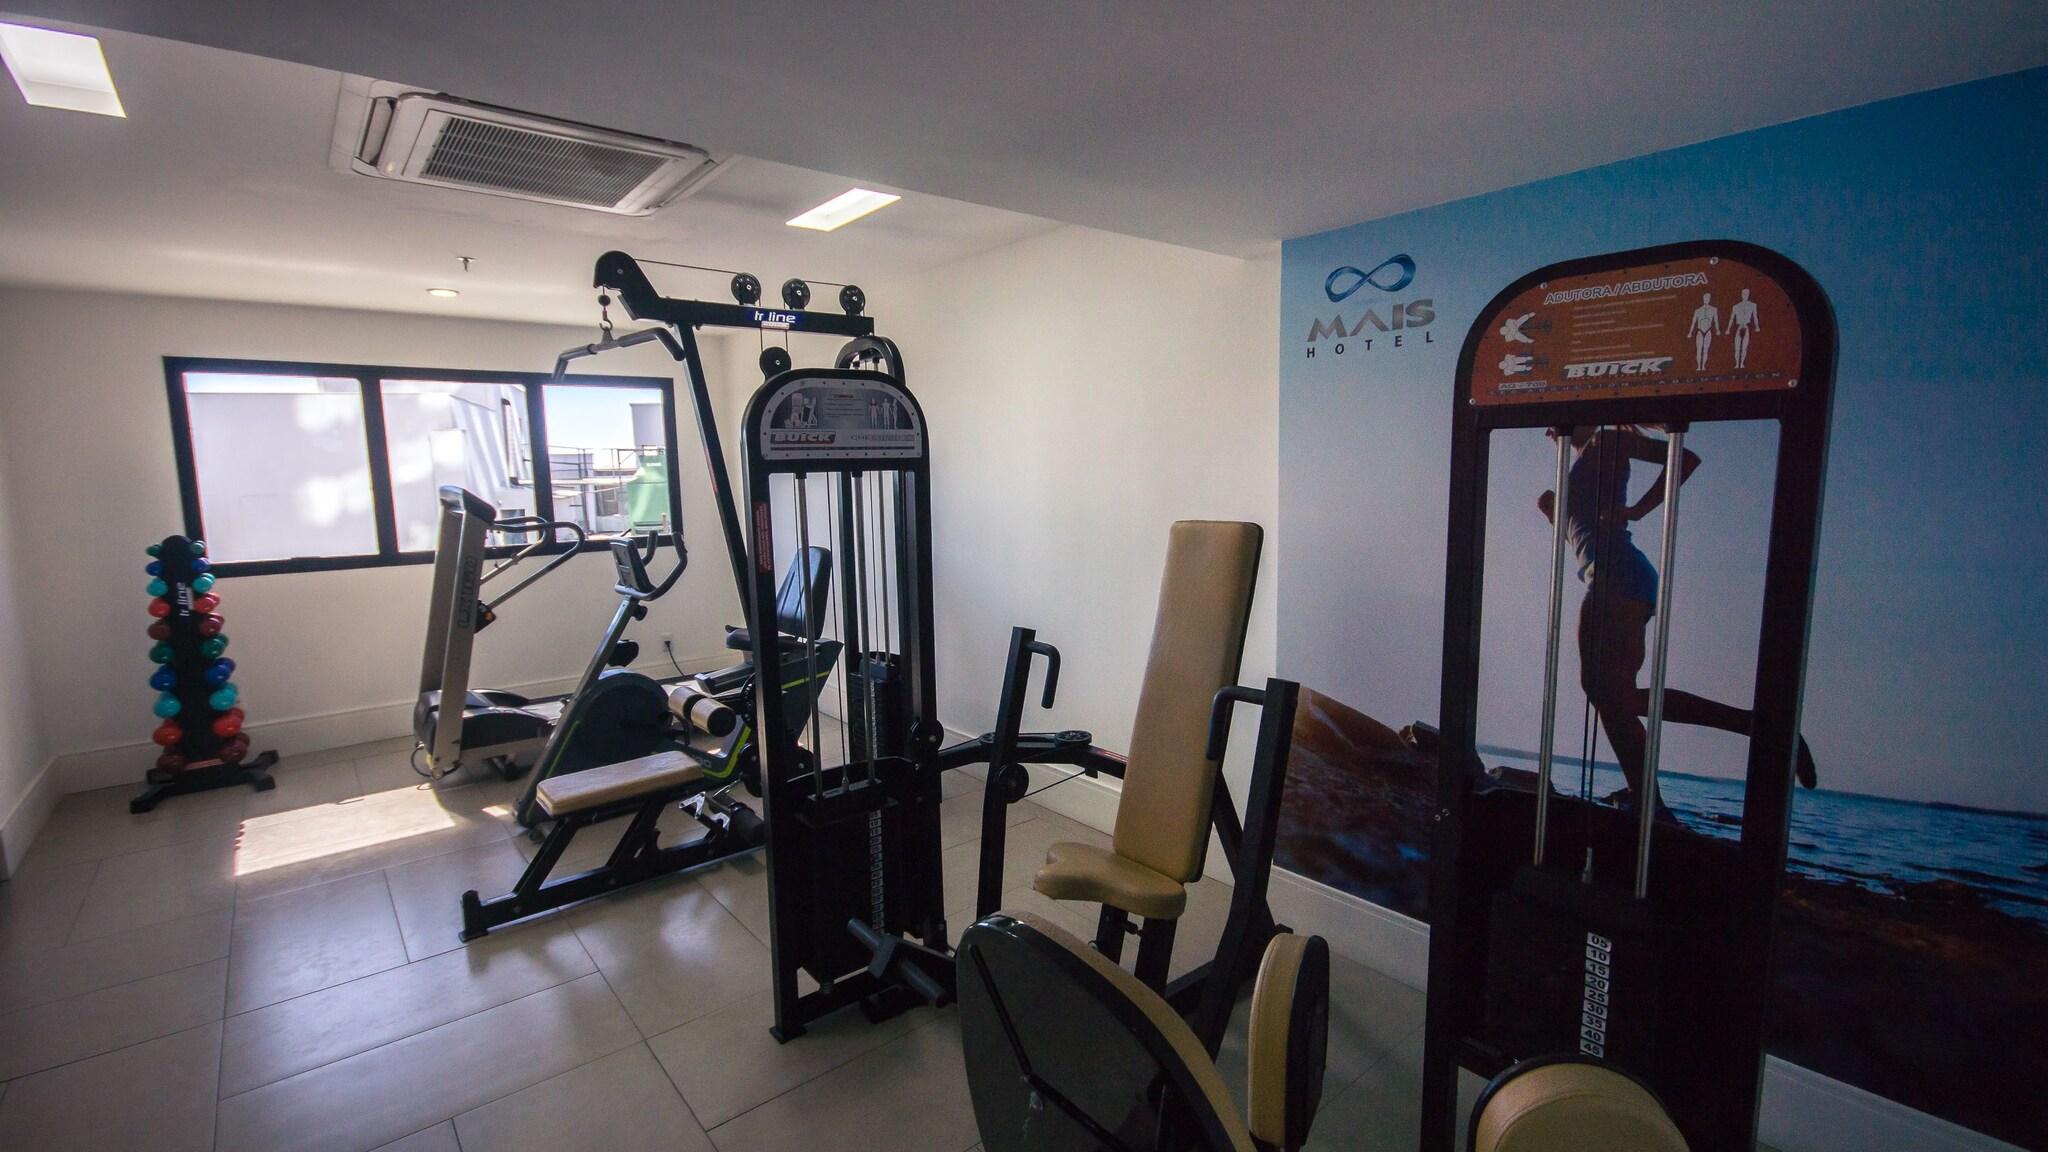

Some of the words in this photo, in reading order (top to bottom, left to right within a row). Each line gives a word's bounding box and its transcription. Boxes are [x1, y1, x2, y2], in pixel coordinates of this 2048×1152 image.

[769, 311, 796, 324] line
[1307, 298, 1436, 342] MAIS
[1306, 331, 1434, 358] HOTEL
[1591, 935, 1608, 949] 05
[1590, 949, 1606, 962] 10
[1589, 962, 1606, 975] 15
[1588, 976, 1605, 989] 20
[1588, 989, 1605, 1002] 25
[1587, 1002, 1603, 1016] 30
[1586, 1015, 1602, 1028] 35
[1585, 1029, 1601, 1042] 40
[1584, 1042, 1600, 1056] 45
